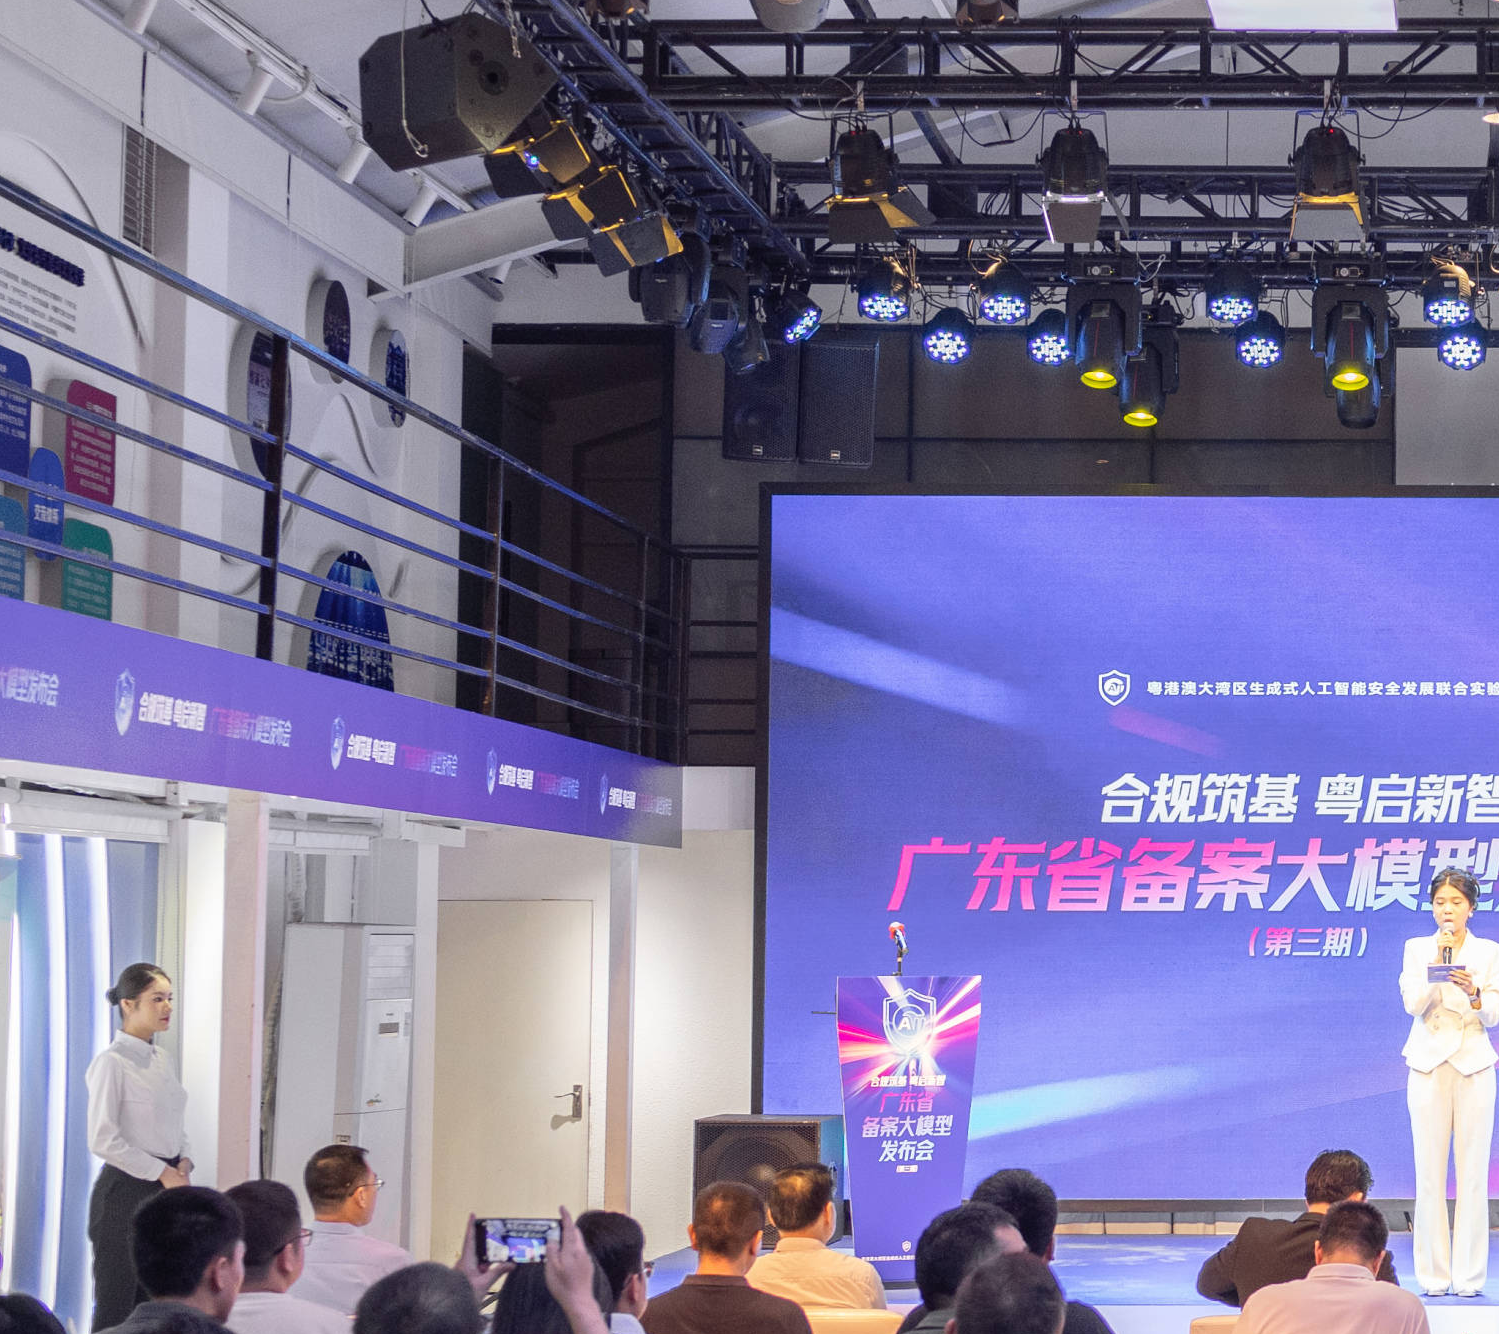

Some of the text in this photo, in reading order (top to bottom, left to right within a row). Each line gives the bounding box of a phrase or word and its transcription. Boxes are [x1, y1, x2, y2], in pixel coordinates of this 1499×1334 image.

[1100, 772, 1300, 824] 合规筑基
[879, 1091, 935, 1114] 广东省
[861, 1114, 954, 1139] 备案大模型
[878, 1139, 935, 1163] 发布会
